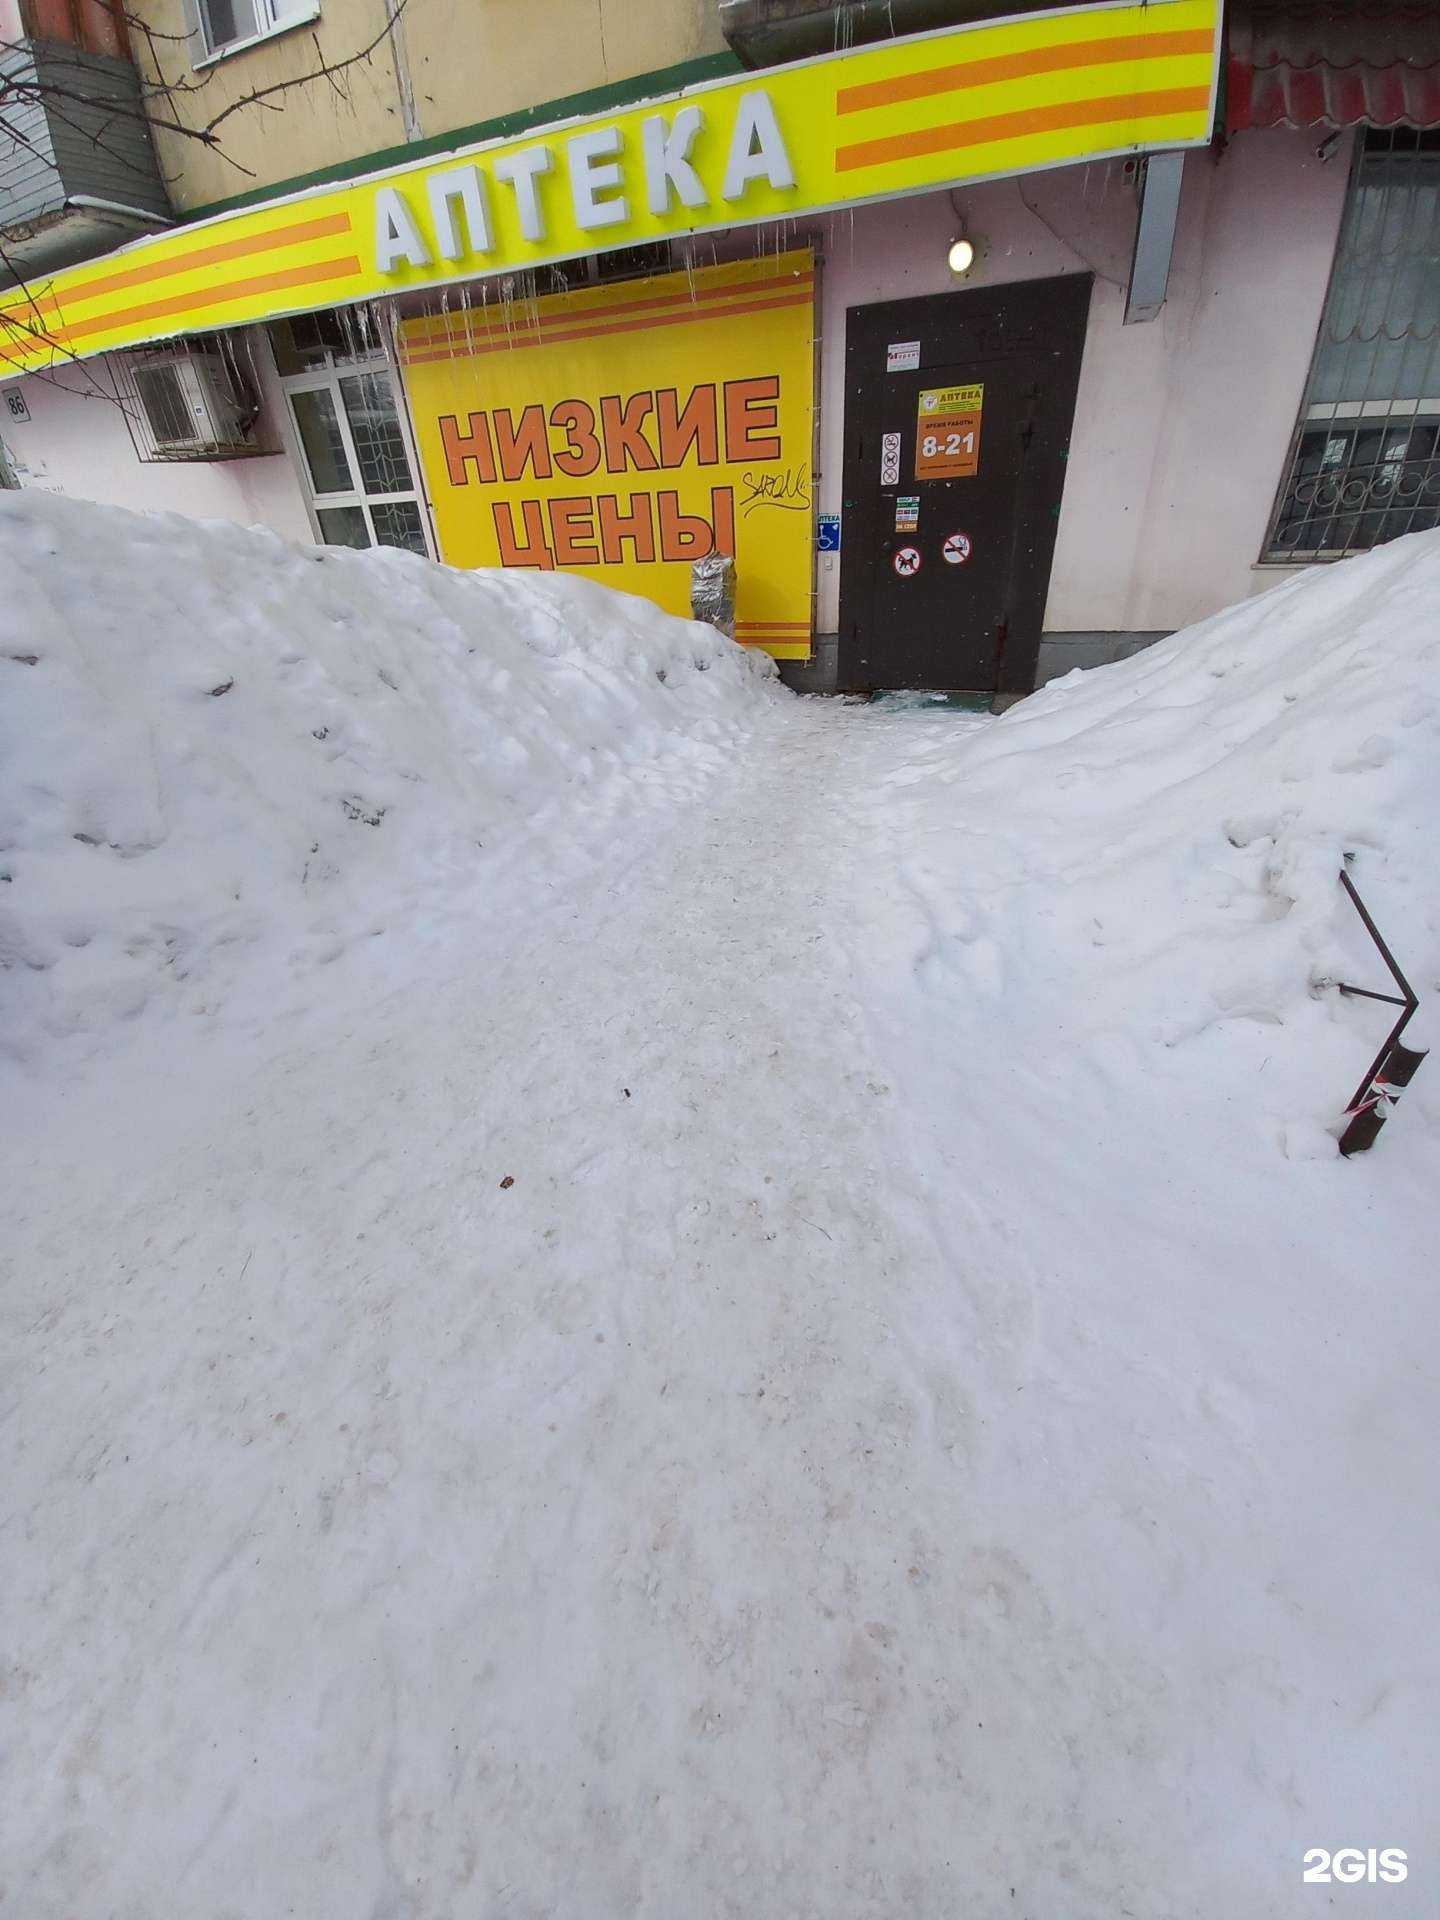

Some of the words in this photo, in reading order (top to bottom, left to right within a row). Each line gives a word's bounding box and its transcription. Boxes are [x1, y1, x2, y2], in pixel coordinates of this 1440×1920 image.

[375, 89, 799, 275] АПТЕКА
[8, 396, 24, 415] 86
[939, 390, 981, 402] АПТЕКА
[438, 375, 781, 486] НИЗКИЕ
[922, 431, 974, 458] 8-21
[492, 486, 736, 571] ЦЕНЫ
